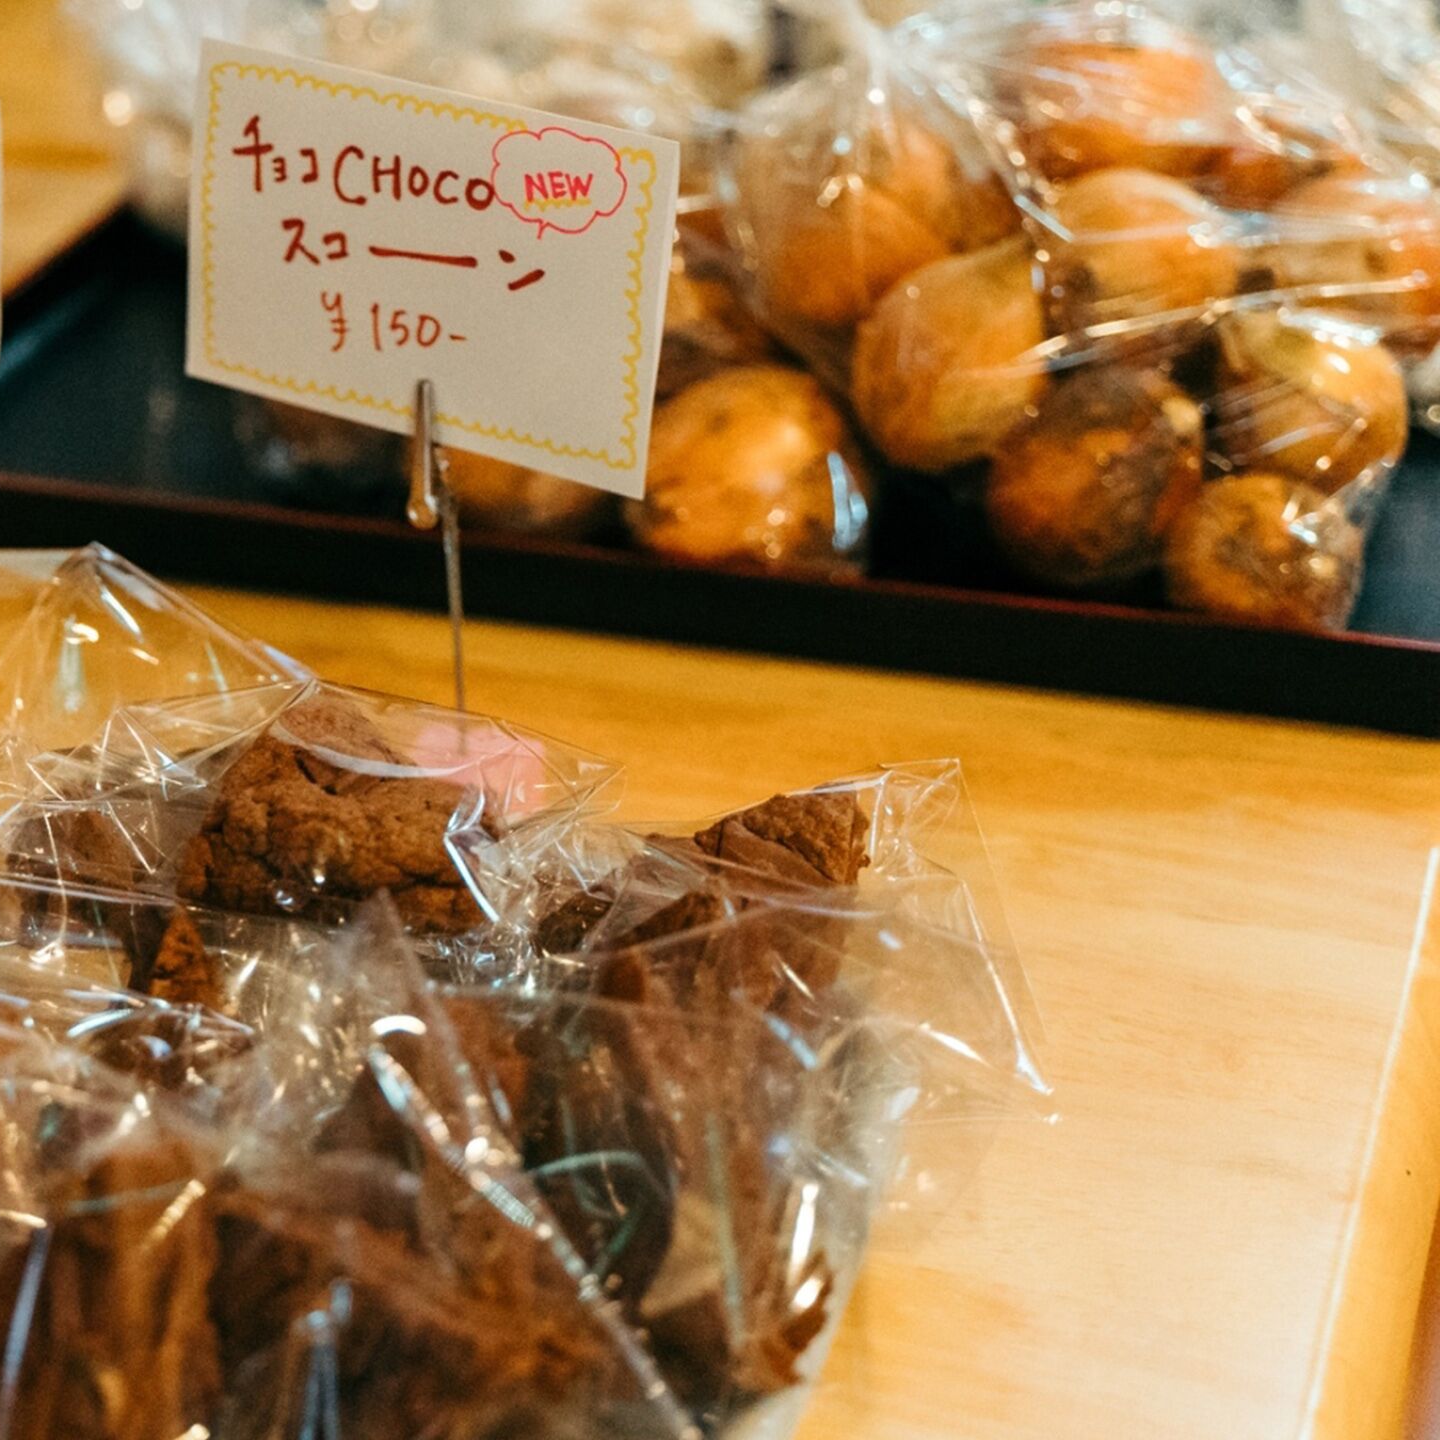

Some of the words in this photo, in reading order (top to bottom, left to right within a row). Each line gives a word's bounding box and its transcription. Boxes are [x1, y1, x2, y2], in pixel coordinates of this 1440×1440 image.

[523, 171, 594, 203] NEW
[281, 217, 546, 291] スコーン
